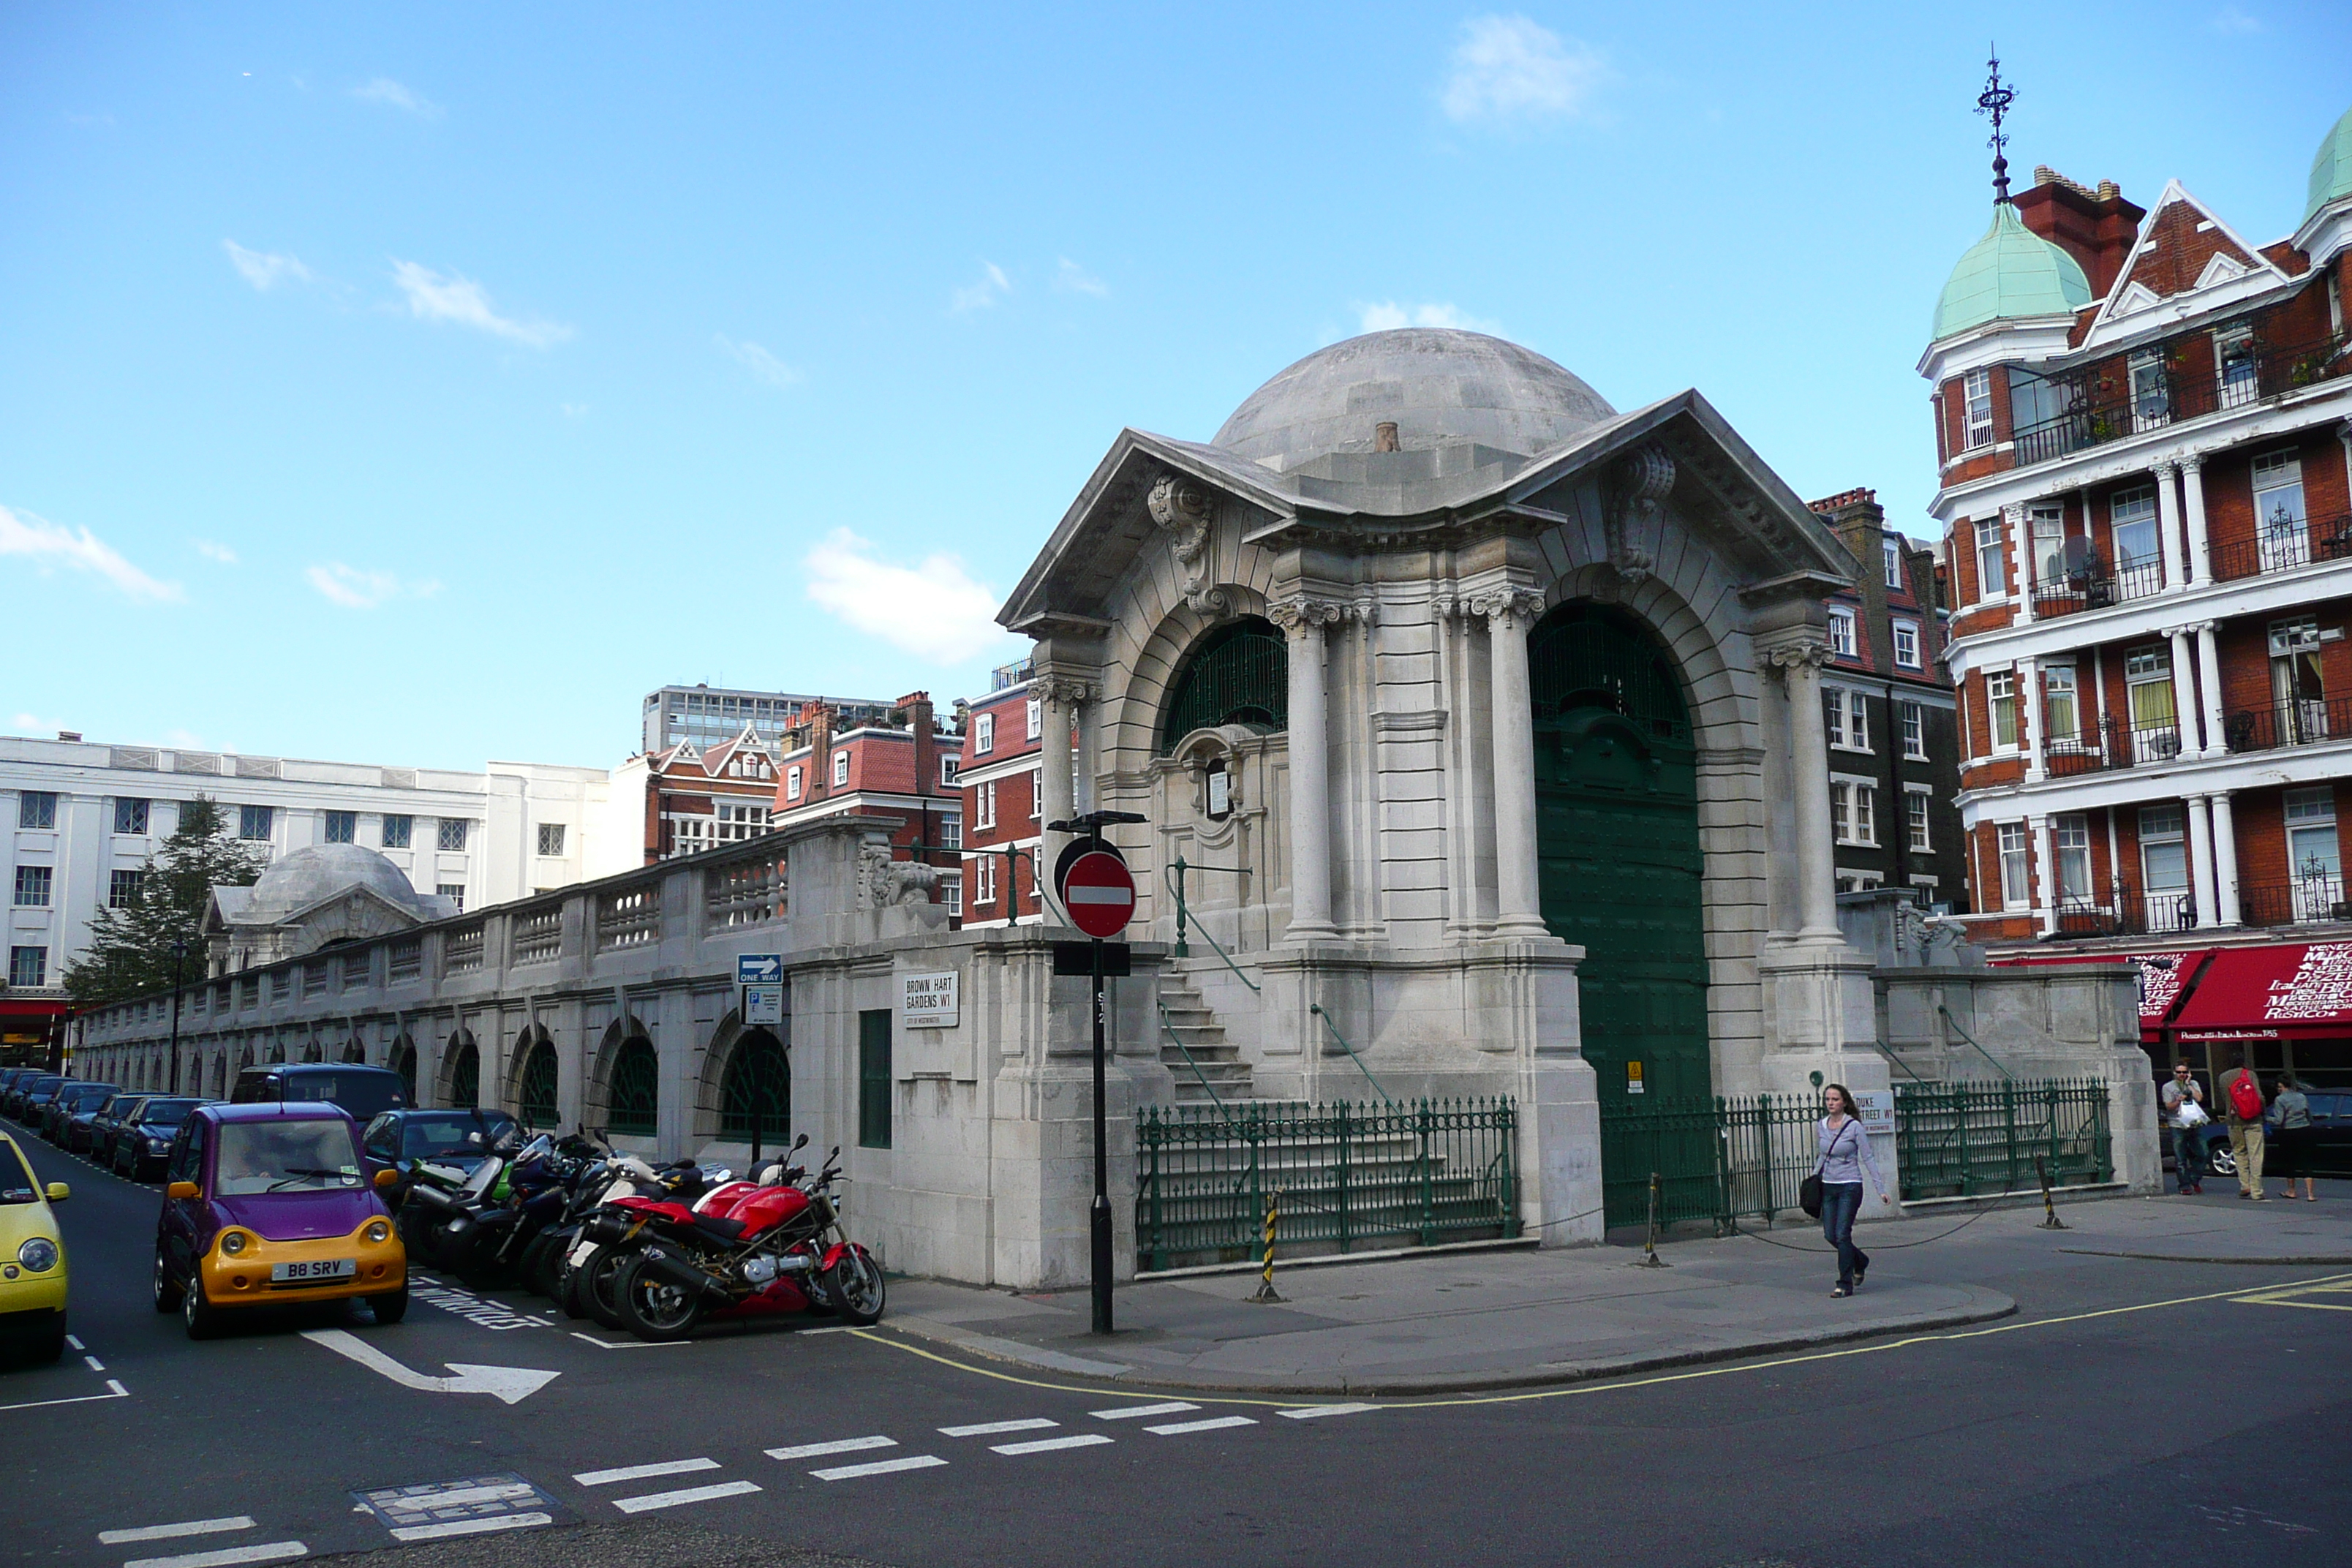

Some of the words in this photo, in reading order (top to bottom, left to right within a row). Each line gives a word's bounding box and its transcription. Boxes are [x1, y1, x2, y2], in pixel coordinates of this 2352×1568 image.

[907, 979, 930, 993] BROWN
[934, 977, 952, 991] HART
[907, 995, 937, 1009] GARDENS
[940, 994, 950, 1007] W1
[1856, 1097, 1874, 1107] DUKE
[1861, 1109, 1880, 1120] TREET
[1884, 1109, 1893, 1119] W1
[288, 1264, 307, 1278] B8
[312, 1261, 341, 1275] SRV
